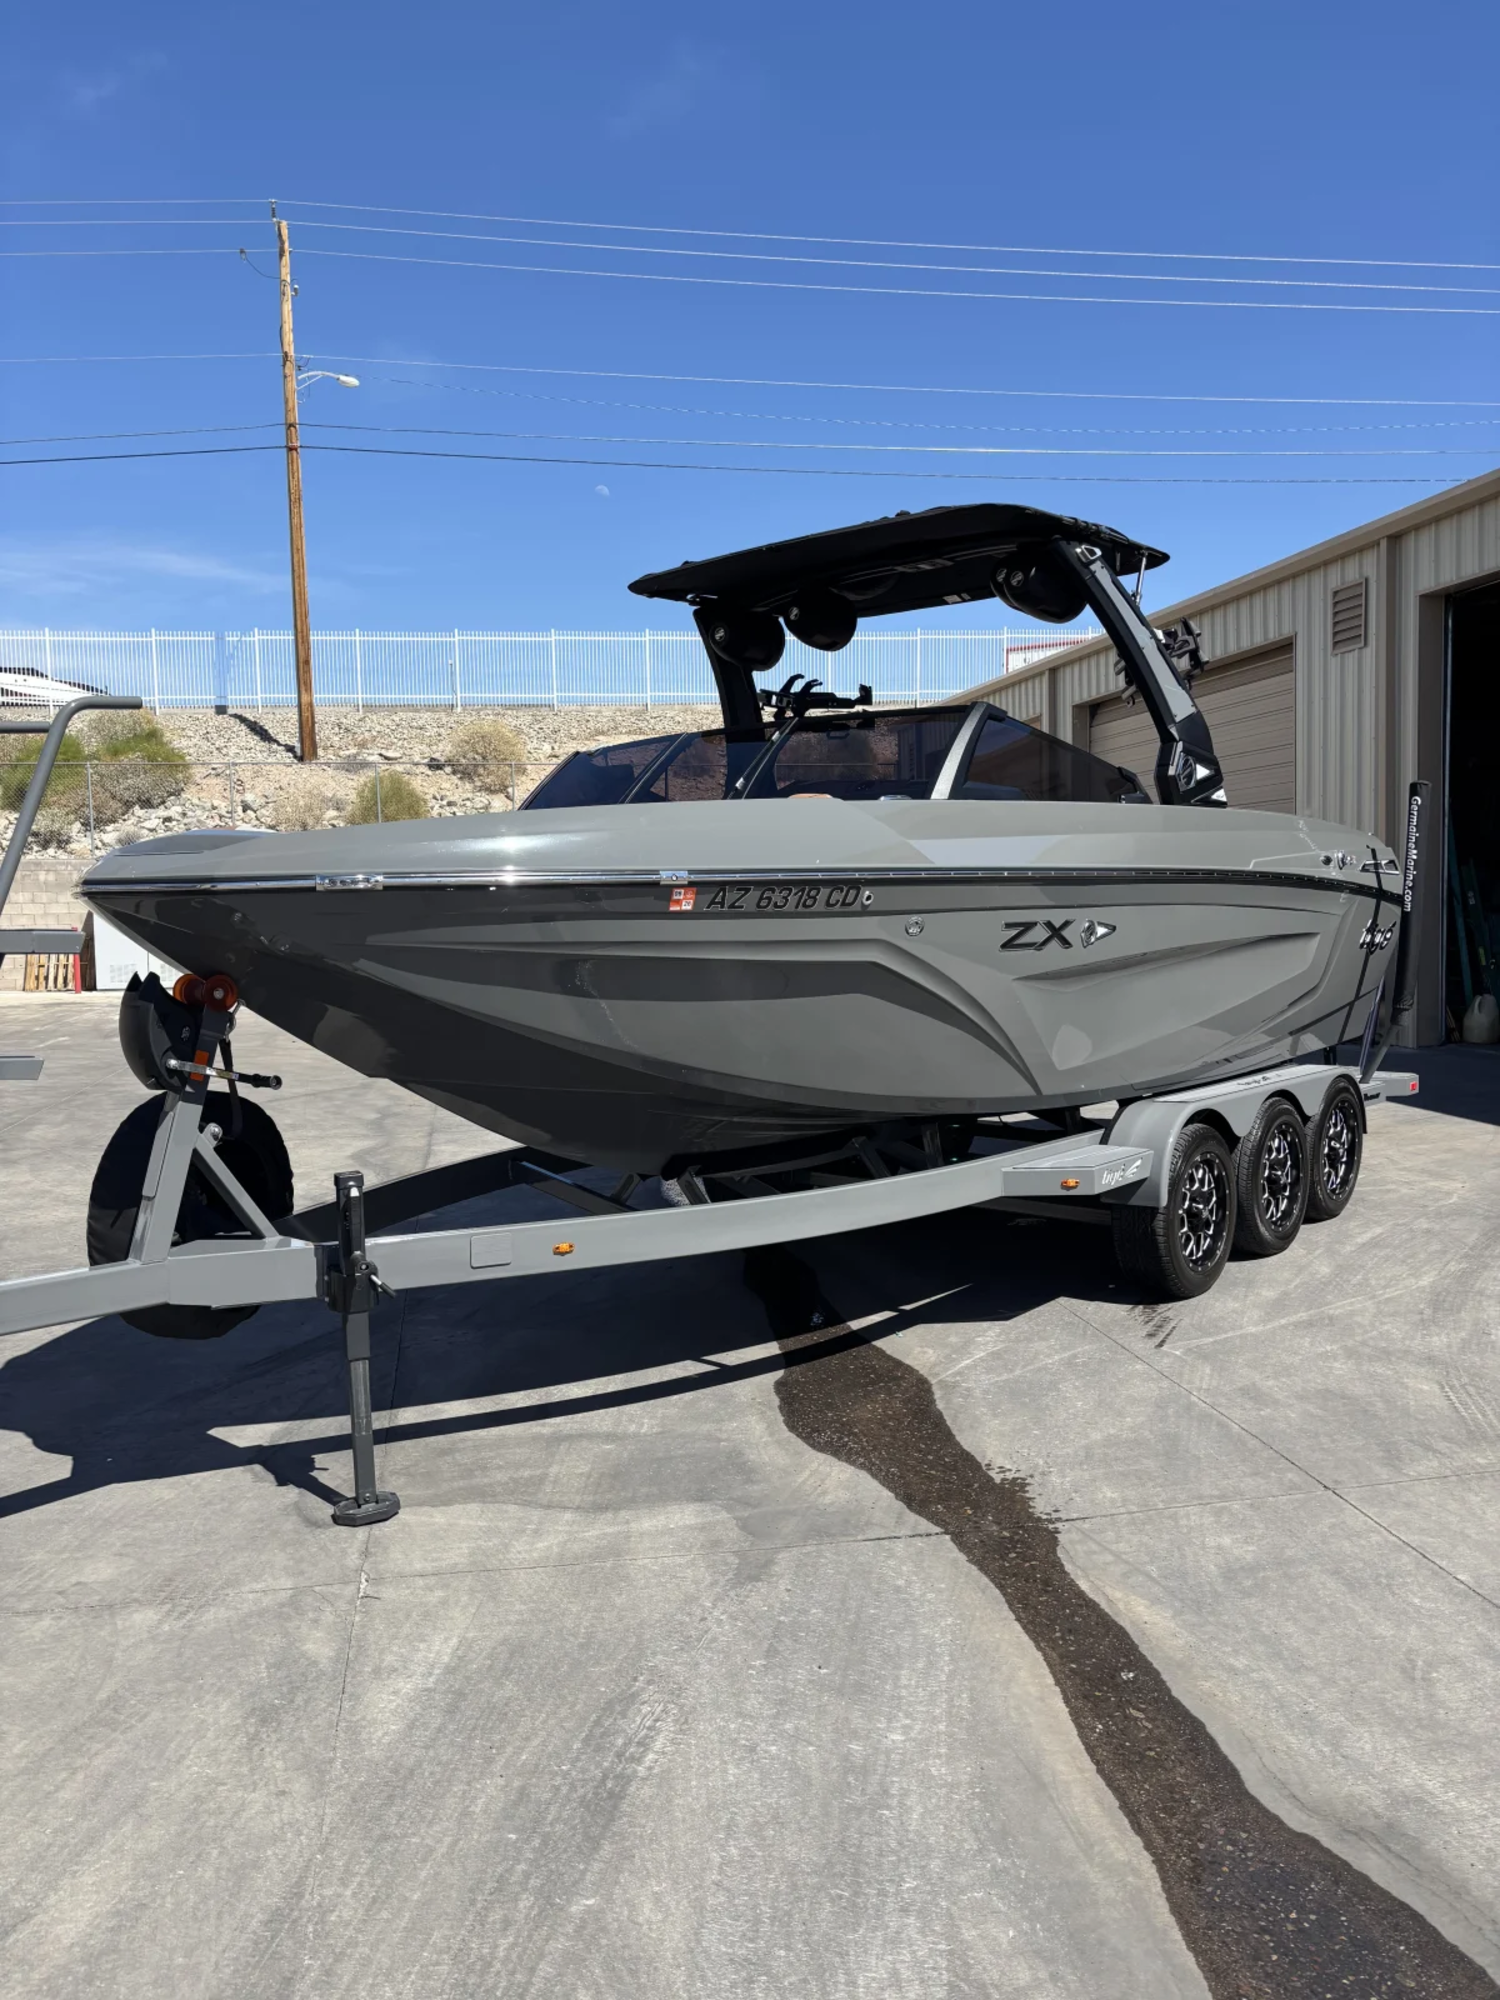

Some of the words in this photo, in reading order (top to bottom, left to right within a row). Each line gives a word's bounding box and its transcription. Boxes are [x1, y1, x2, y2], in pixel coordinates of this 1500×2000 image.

[1403, 796, 1422, 912] GermaineMarine.com
[703, 886, 753, 910] AZ
[755, 885, 823, 910] 6318
[824, 885, 862, 910] CD
[999, 919, 1075, 951] ZX
